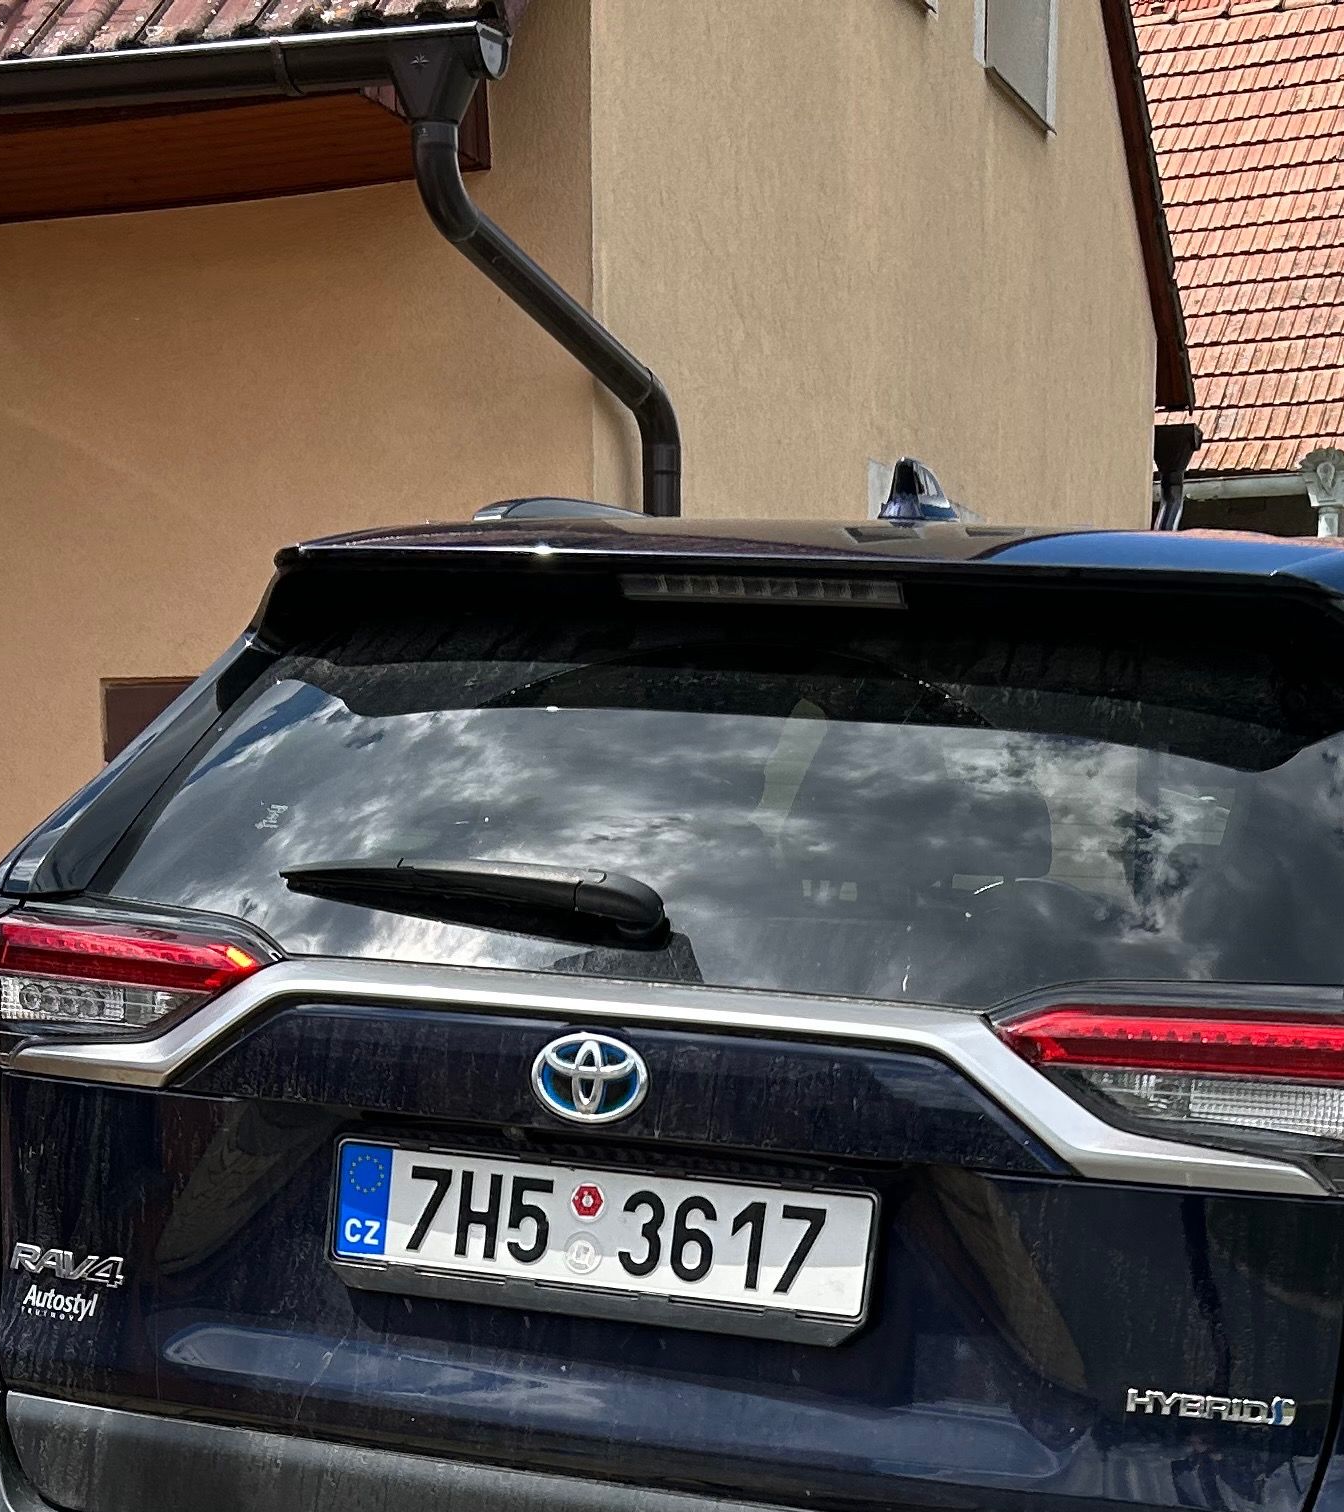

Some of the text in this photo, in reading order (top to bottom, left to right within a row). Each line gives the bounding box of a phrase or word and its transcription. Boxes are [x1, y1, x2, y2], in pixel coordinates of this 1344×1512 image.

[344, 1219, 380, 1245] CZ
[406, 1165, 827, 1294] 7H5 3617
[10, 1242, 124, 1288] RAV4
[23, 1284, 98, 1321] Autostyl
[1126, 1388, 1270, 1424] HYBRID
